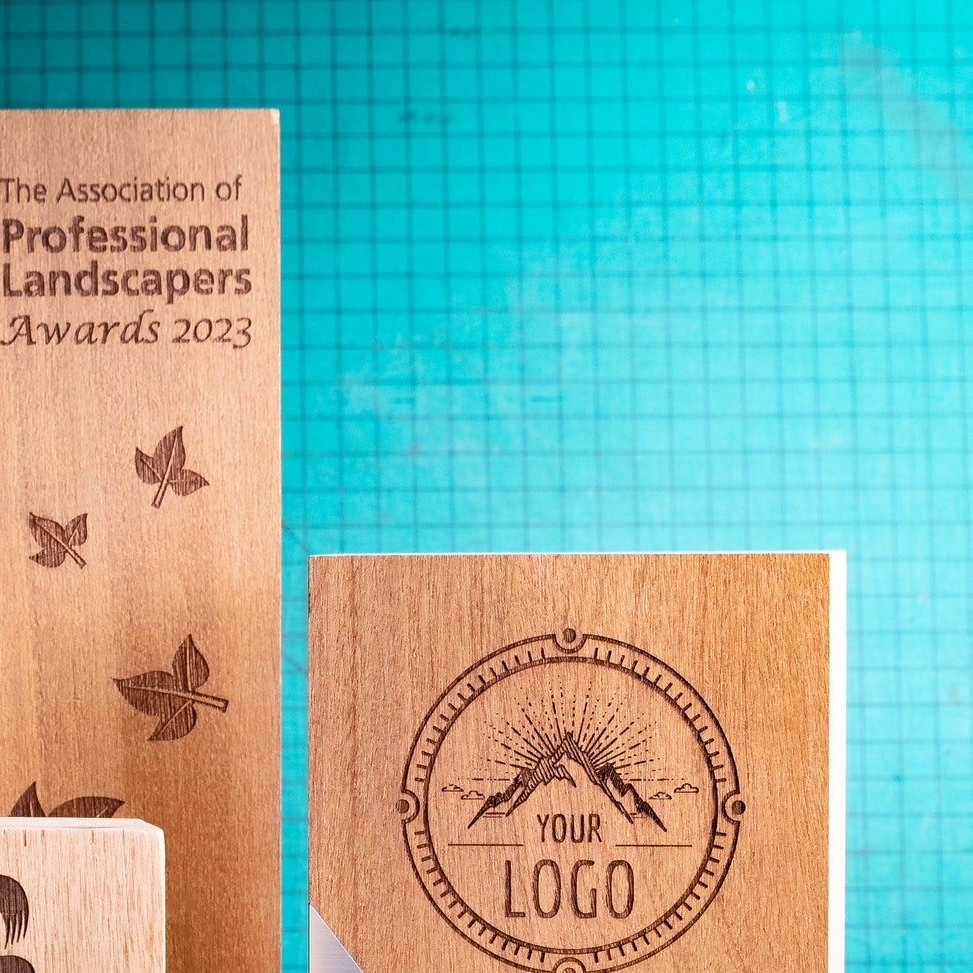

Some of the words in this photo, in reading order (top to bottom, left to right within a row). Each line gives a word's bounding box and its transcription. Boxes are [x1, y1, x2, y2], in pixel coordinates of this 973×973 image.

[0, 177, 47, 203] The
[56, 177, 204, 204] Association
[216, 174, 243, 202] of
[2, 215, 249, 254] Professional
[2, 260, 252, 304] Landscapers
[0, 310, 160, 346] Awards
[171, 316, 253, 350] 2023
[536, 813, 603, 843] YOUR
[504, 859, 635, 919] LOGO
